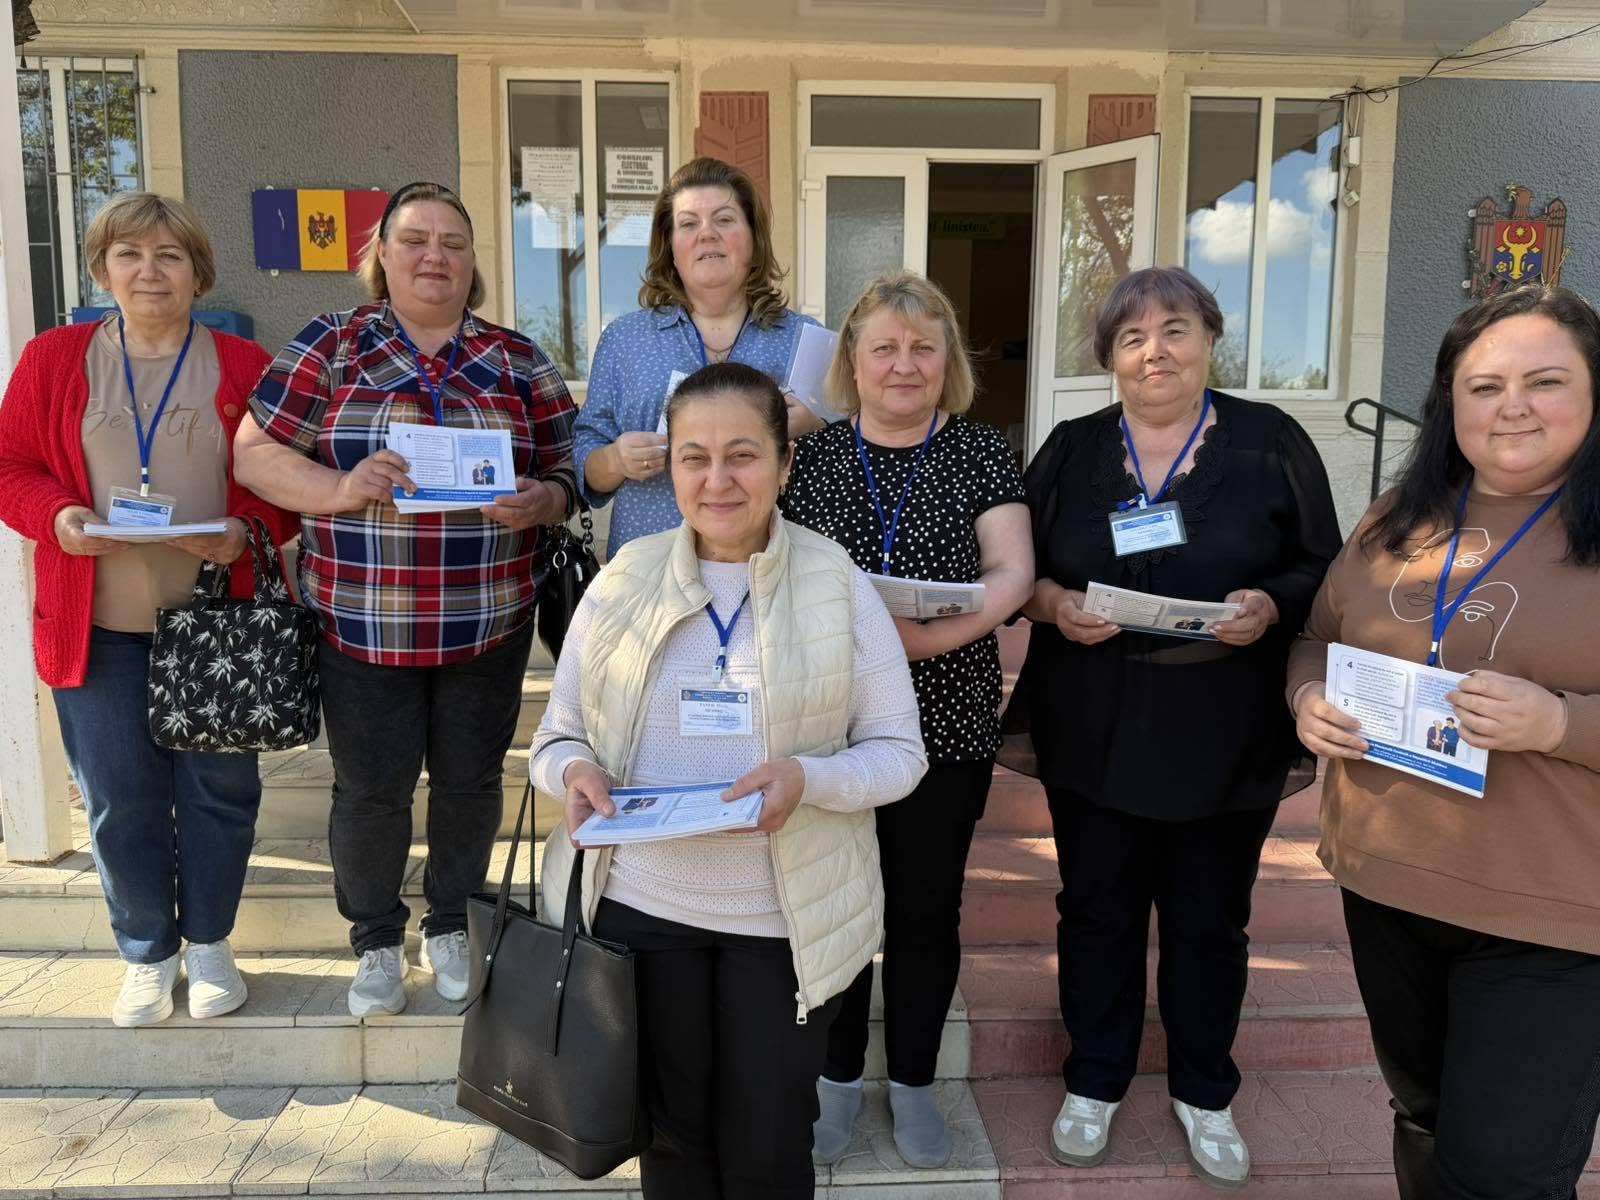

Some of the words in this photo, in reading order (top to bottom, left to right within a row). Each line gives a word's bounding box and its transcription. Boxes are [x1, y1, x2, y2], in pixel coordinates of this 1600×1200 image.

[621, 160, 649, 170] ELECTORAL
[1346, 661, 1354, 670] 4
[1343, 698, 1350, 707] 5
